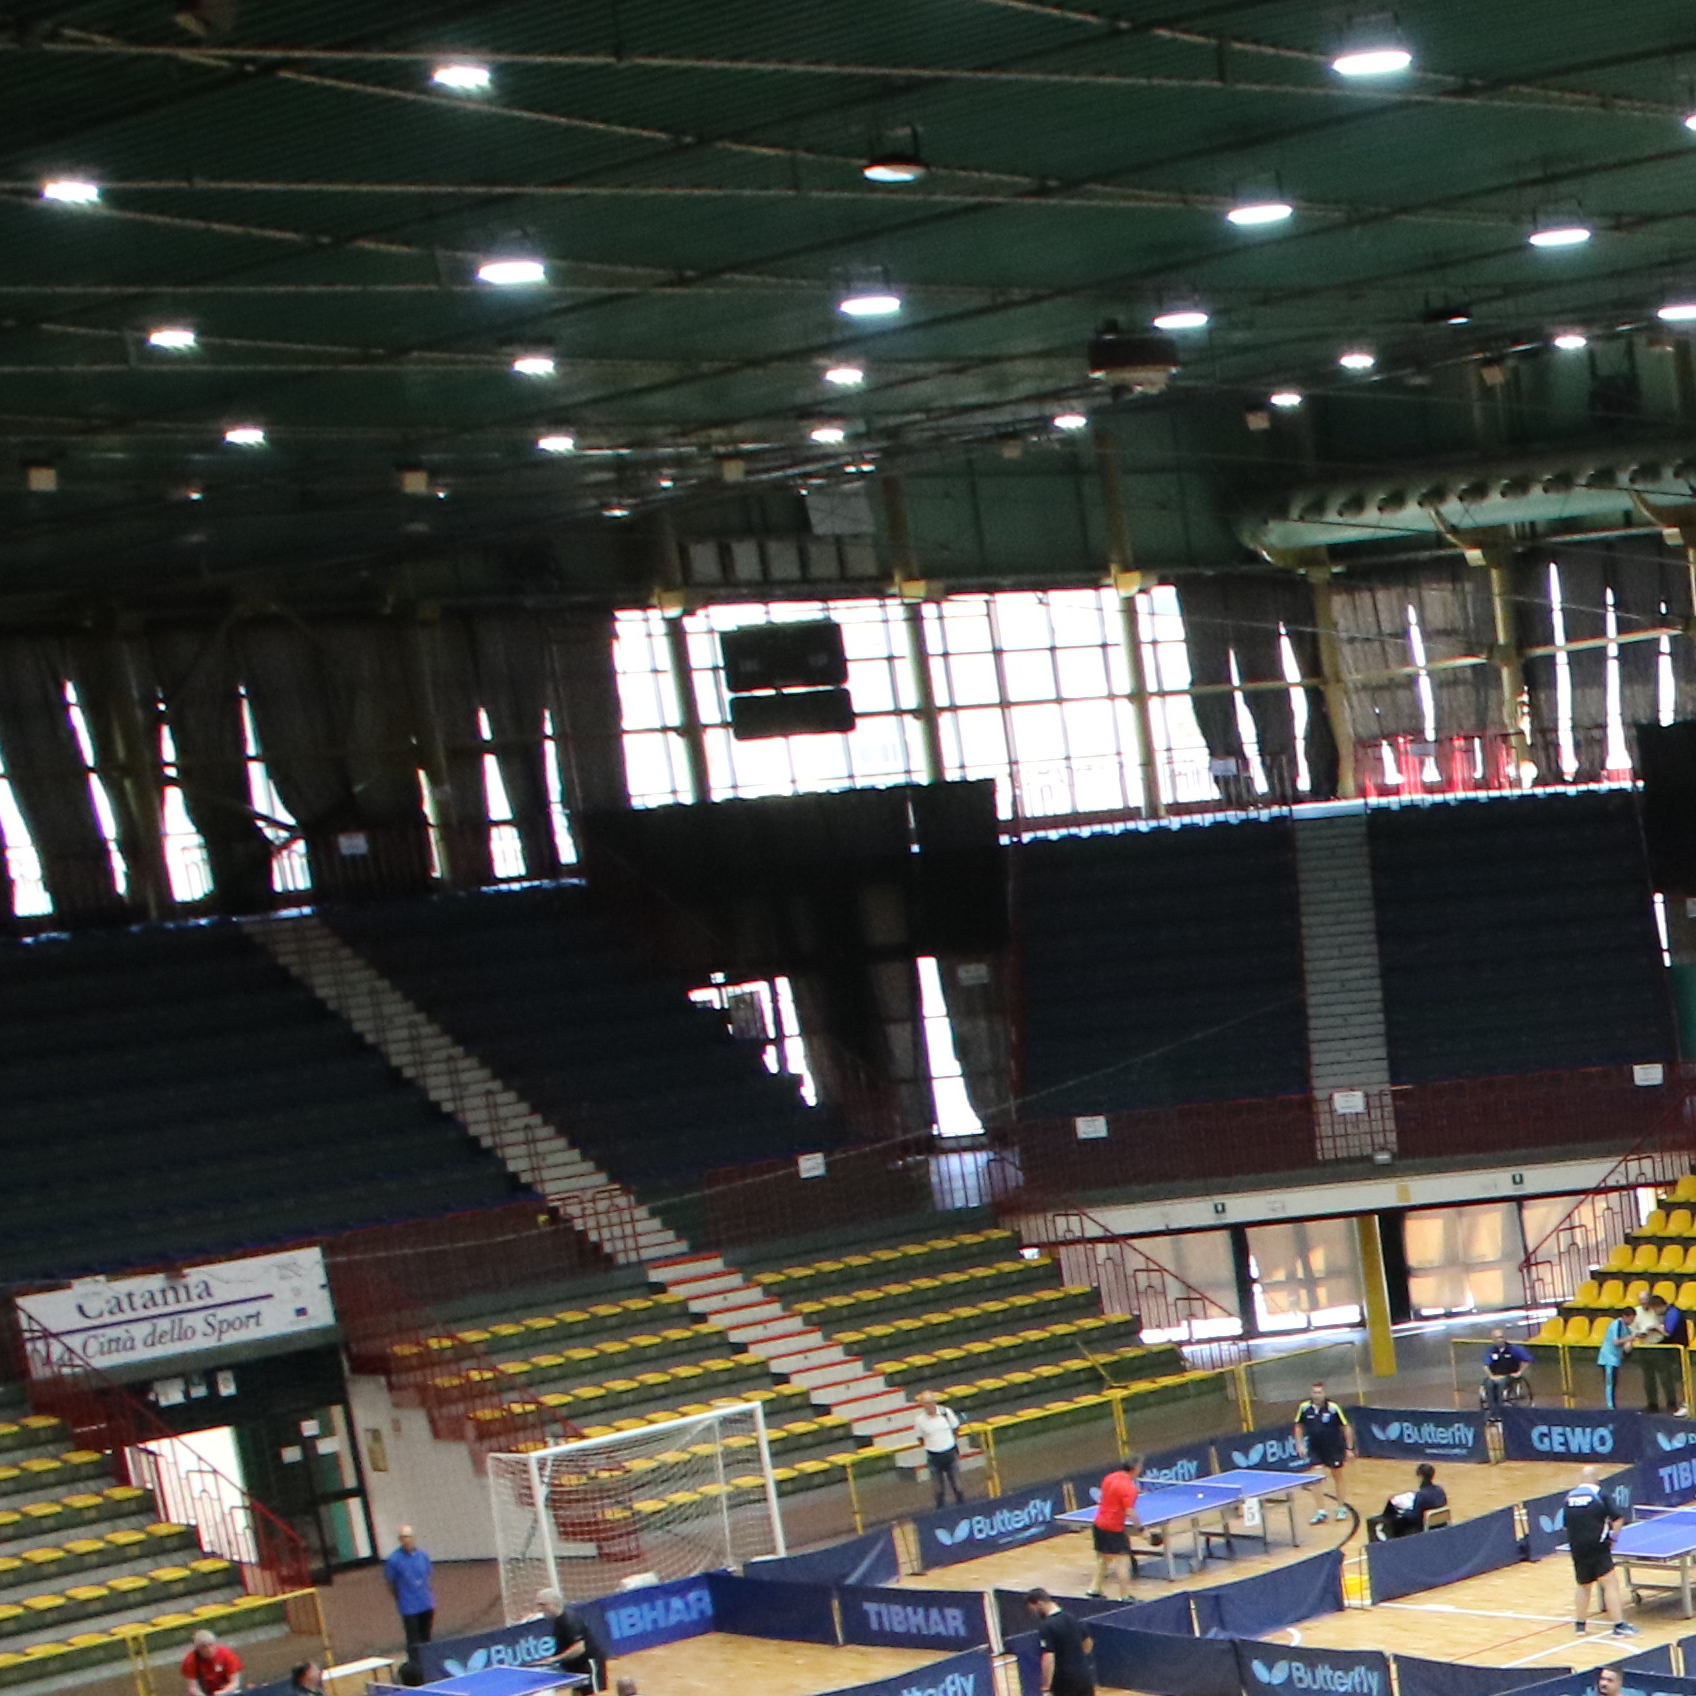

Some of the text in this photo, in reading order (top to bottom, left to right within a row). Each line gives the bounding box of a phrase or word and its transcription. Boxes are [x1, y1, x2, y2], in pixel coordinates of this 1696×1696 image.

[144, 1318, 195, 1348] dello
[202, 1309, 262, 1342] Sport
[1402, 1422, 1475, 1449] Butterfly
[1531, 1424, 1608, 1454] GEWO
[972, 1499, 1053, 1541] Butterfly
[604, 1588, 714, 1640] IBHAR
[862, 1602, 967, 1637] TIBHAR
[490, 1635, 556, 1667] Butte
[1291, 1662, 1379, 1696] Butterfly
